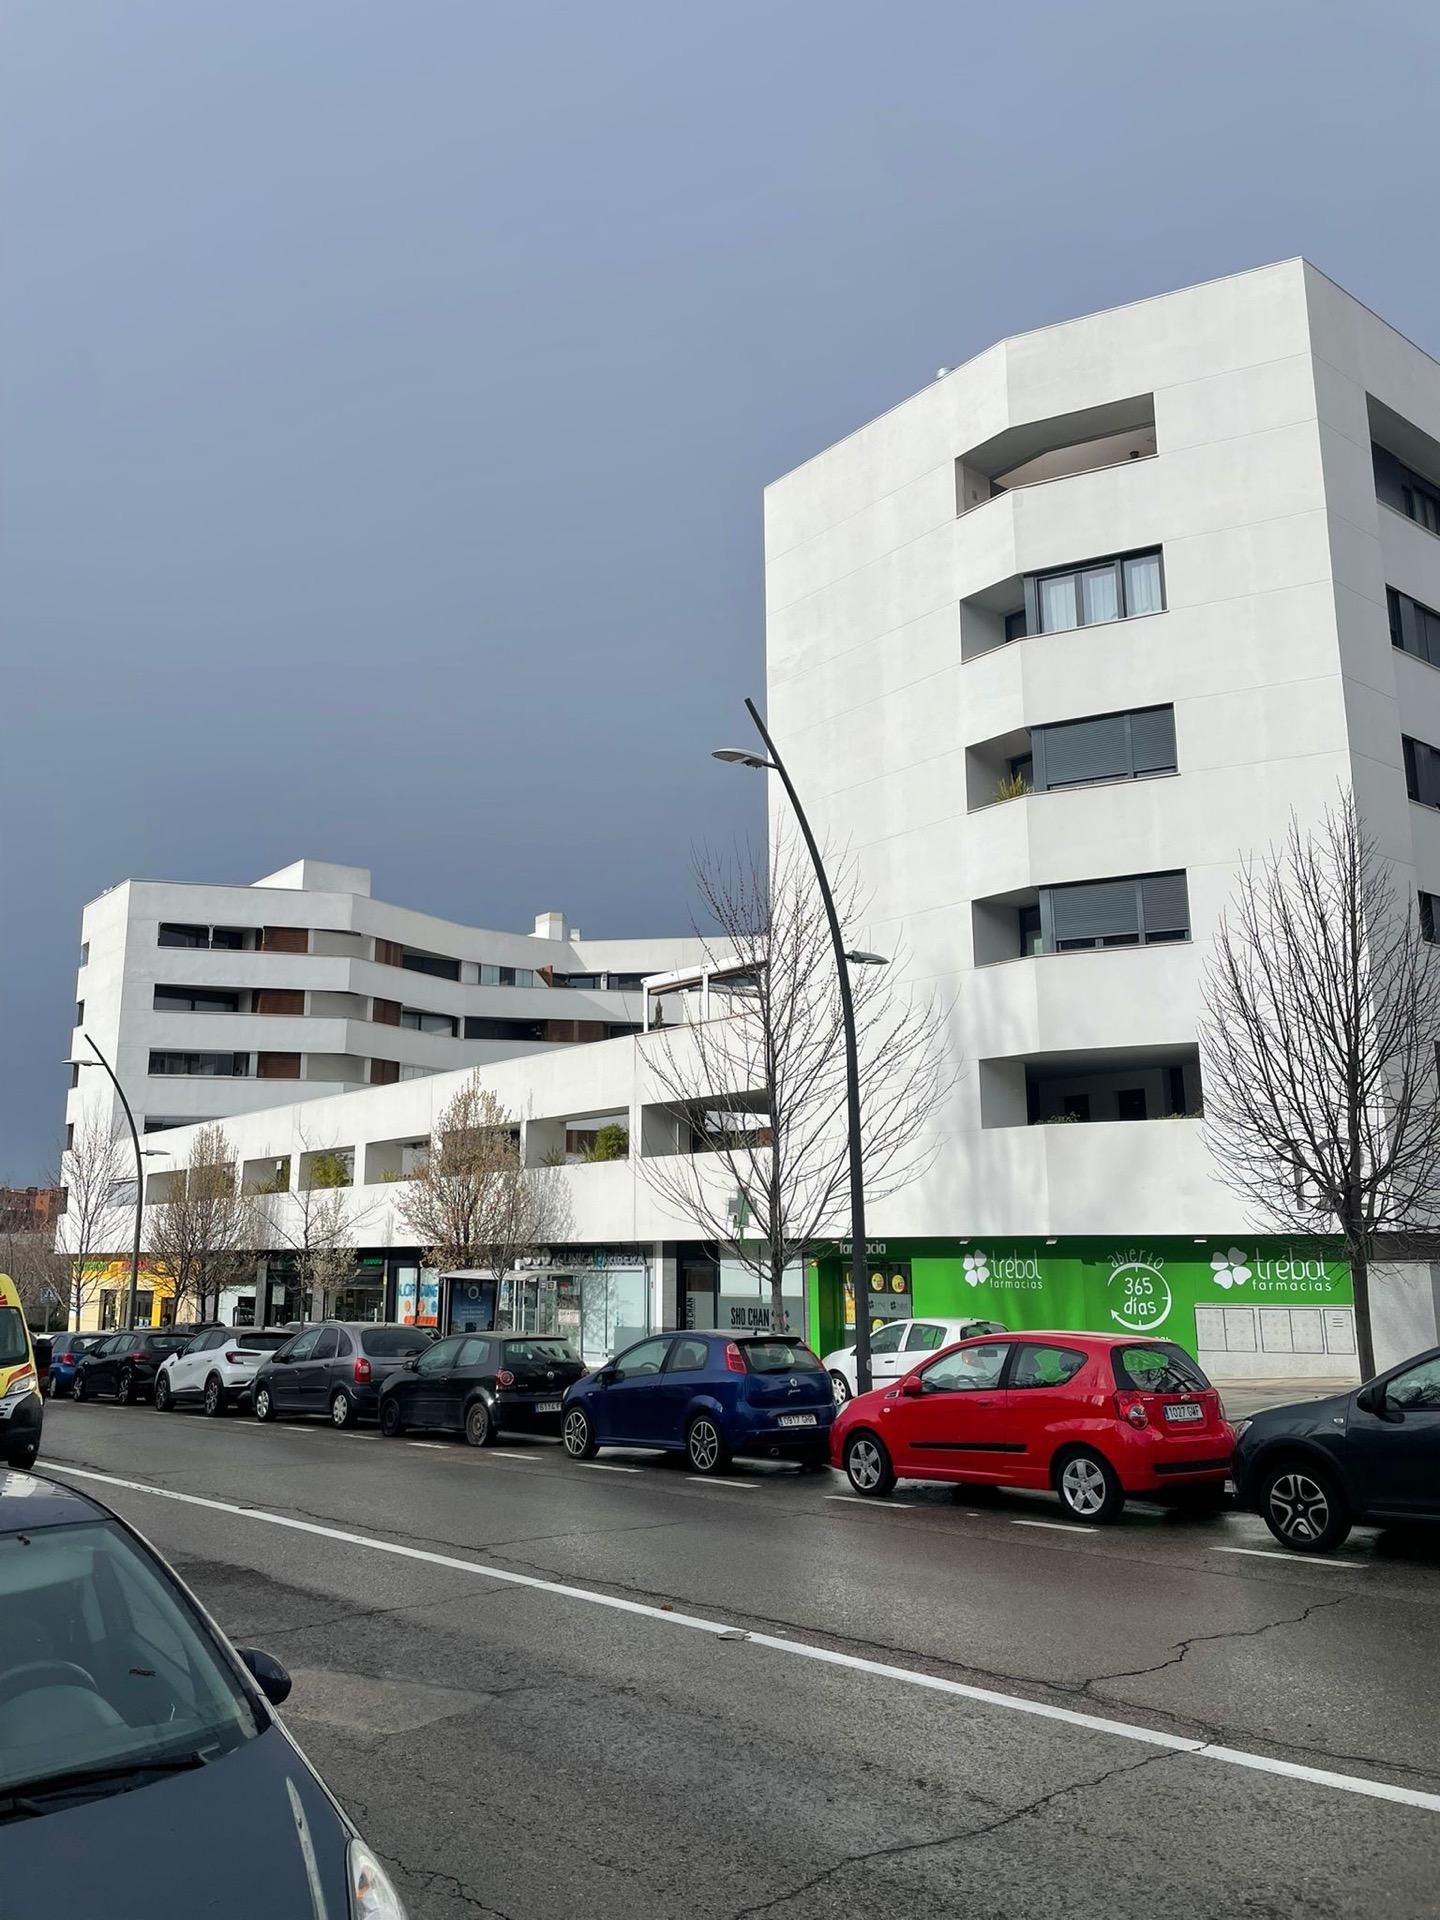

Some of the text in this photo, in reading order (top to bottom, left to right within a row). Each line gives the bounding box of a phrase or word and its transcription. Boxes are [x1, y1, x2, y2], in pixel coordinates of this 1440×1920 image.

[840, 1240, 887, 1255] faracia
[990, 1248, 1043, 1280] trébol
[1107, 1248, 1165, 1270] abierto
[1252, 1247, 1331, 1281] trébol
[990, 1278, 1043, 1290] farmacias
[1124, 1277, 1153, 1295] 365
[1252, 1279, 1332, 1292] farmacias
[1123, 1296, 1157, 1315] días
[730, 1306, 770, 1327] SHO CHAN
[1168, 1405, 1185, 1418] 1027
